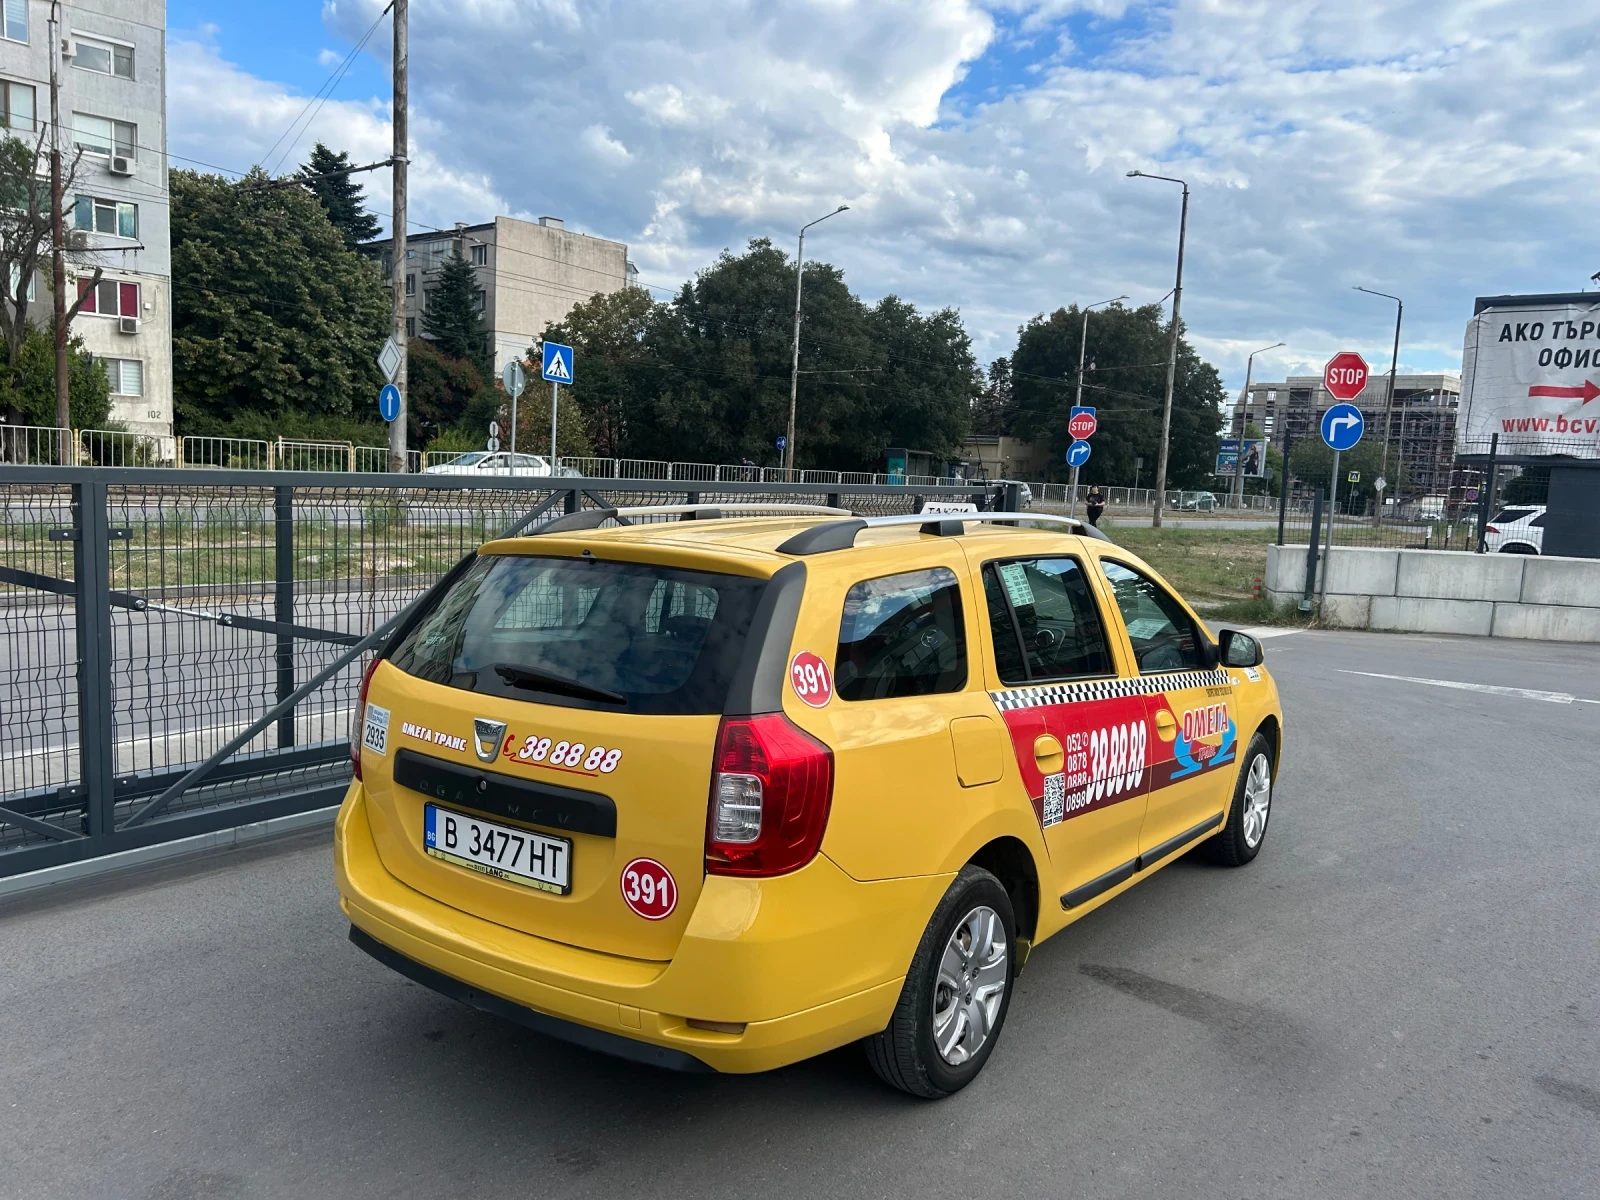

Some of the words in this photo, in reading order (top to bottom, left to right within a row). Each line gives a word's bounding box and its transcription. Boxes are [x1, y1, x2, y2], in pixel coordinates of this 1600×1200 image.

[1498, 321, 1545, 343] АКО
[1329, 367, 1364, 385] STOP
[147, 410, 162, 419] 102
[1071, 421, 1094, 431] STOP
[793, 662, 829, 695] 391
[1183, 702, 1229, 742] ОМЕГА
[365, 723, 386, 750] 2935
[434, 731, 468, 752] ТРАНС
[1066, 732, 1083, 753] 052
[518, 735, 552, 761] 38
[549, 740, 586, 767] 88
[583, 746, 622, 773] 88
[1067, 751, 1088, 773] 0878
[1066, 790, 1086, 813] 0898
[426, 830, 436, 842] BG
[445, 816, 458, 849] B
[469, 824, 525, 867] 3477
[530, 839, 563, 878] HT
[626, 870, 668, 907] 391
